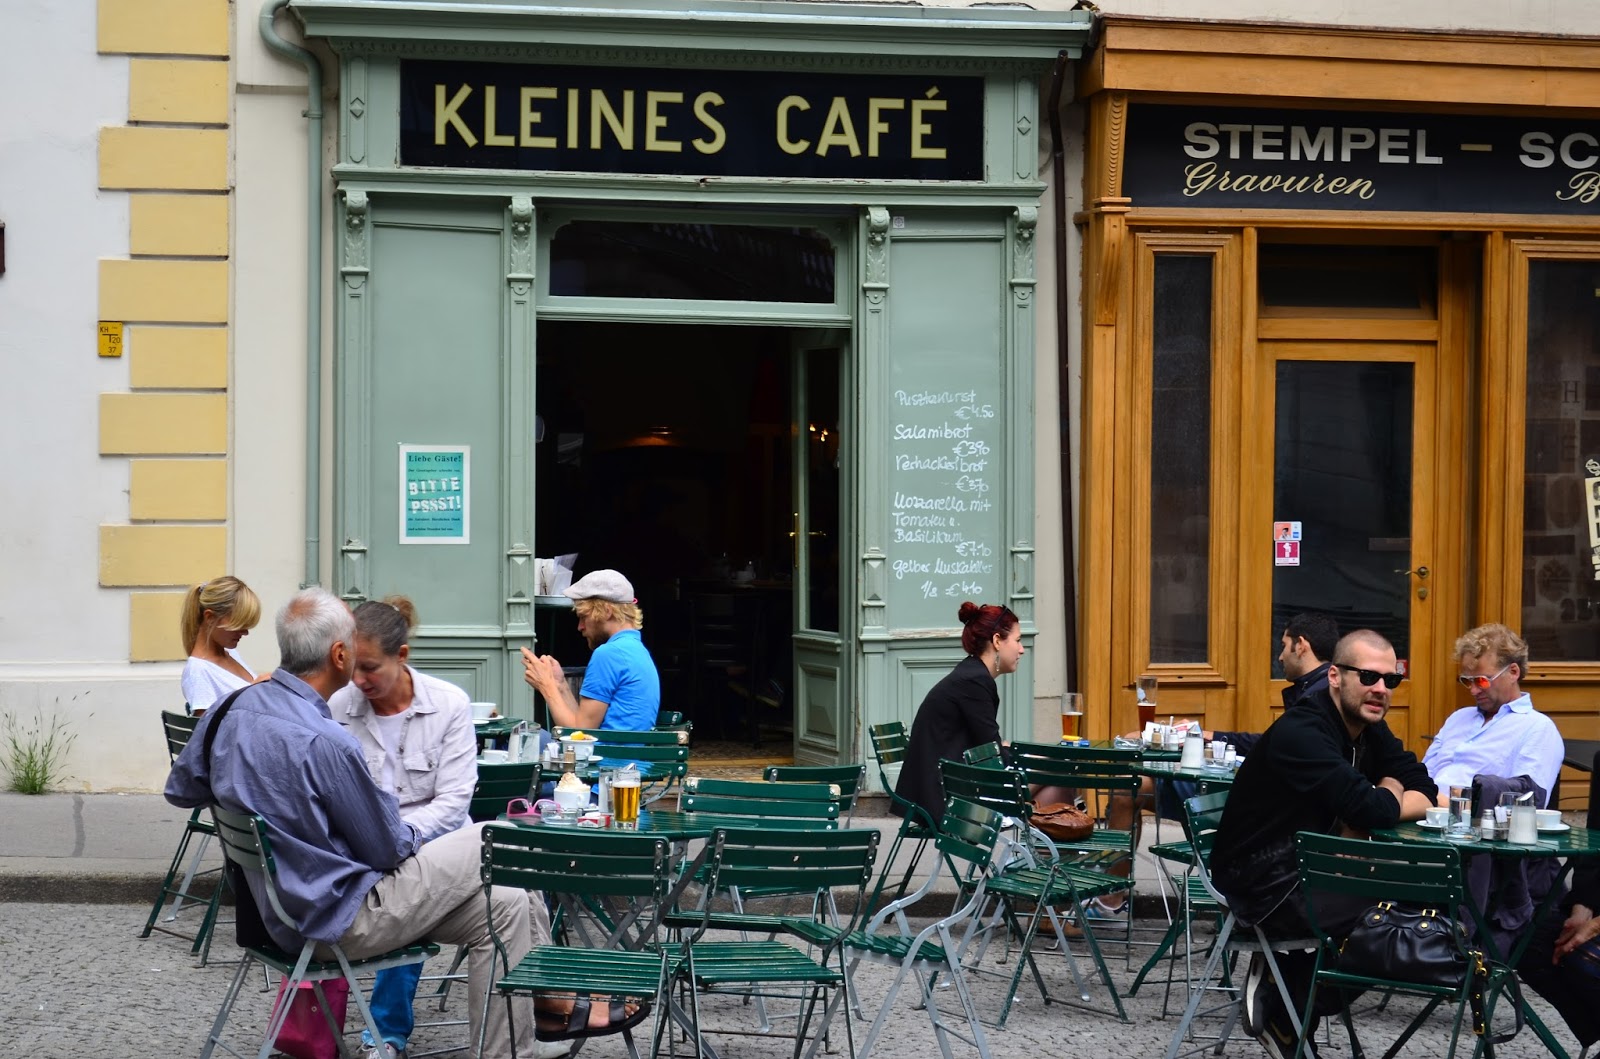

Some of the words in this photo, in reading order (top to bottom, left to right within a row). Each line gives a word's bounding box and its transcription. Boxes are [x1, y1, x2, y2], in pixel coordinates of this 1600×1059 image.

[434, 82, 726, 155] KLEINES
[776, 85, 948, 160] CAFÉ
[1182, 121, 1443, 165] STEMPEL
[1182, 161, 1376, 199] Gravuren
[107, 346, 117, 354] 37
[893, 421, 973, 440] Salamibrot
[408, 455, 432, 463] Liebe
[434, 454, 462, 463] Gäste!
[408, 476, 460, 496] BITTE
[411, 495, 461, 514] PSSST!
[893, 491, 967, 512] Mozzarella
[970, 498, 992, 512] mit
[891, 511, 945, 527] Tomaten
[893, 528, 965, 544] Basilikum
